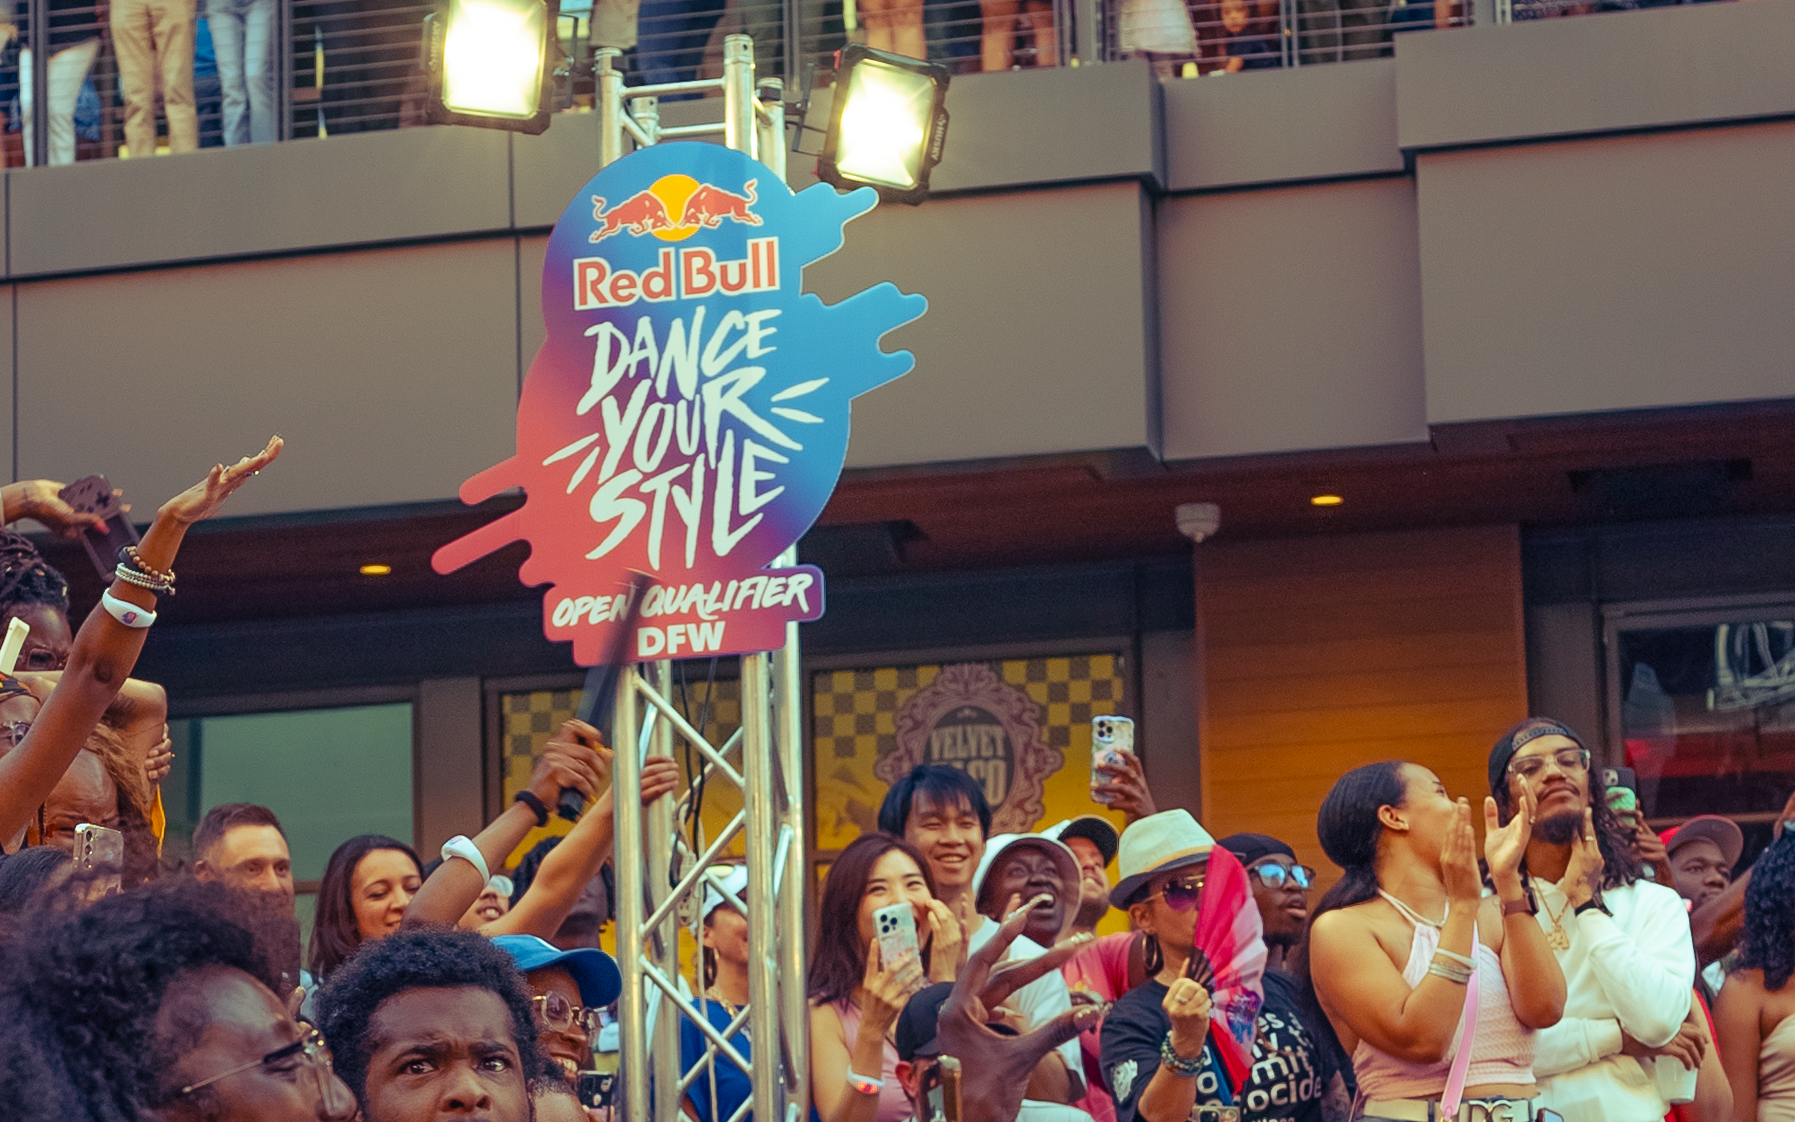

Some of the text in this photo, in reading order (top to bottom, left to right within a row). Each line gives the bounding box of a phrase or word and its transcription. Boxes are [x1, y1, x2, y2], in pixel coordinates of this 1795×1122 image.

[932, 124, 944, 160] HUSKY
[575, 238, 778, 309] Red Bull
[576, 305, 782, 415] DANCE
[598, 366, 803, 485] YOUR
[585, 430, 789, 571] STYLE
[552, 573, 814, 628] OPEN QUALIFIER
[637, 621, 726, 657] DFW
